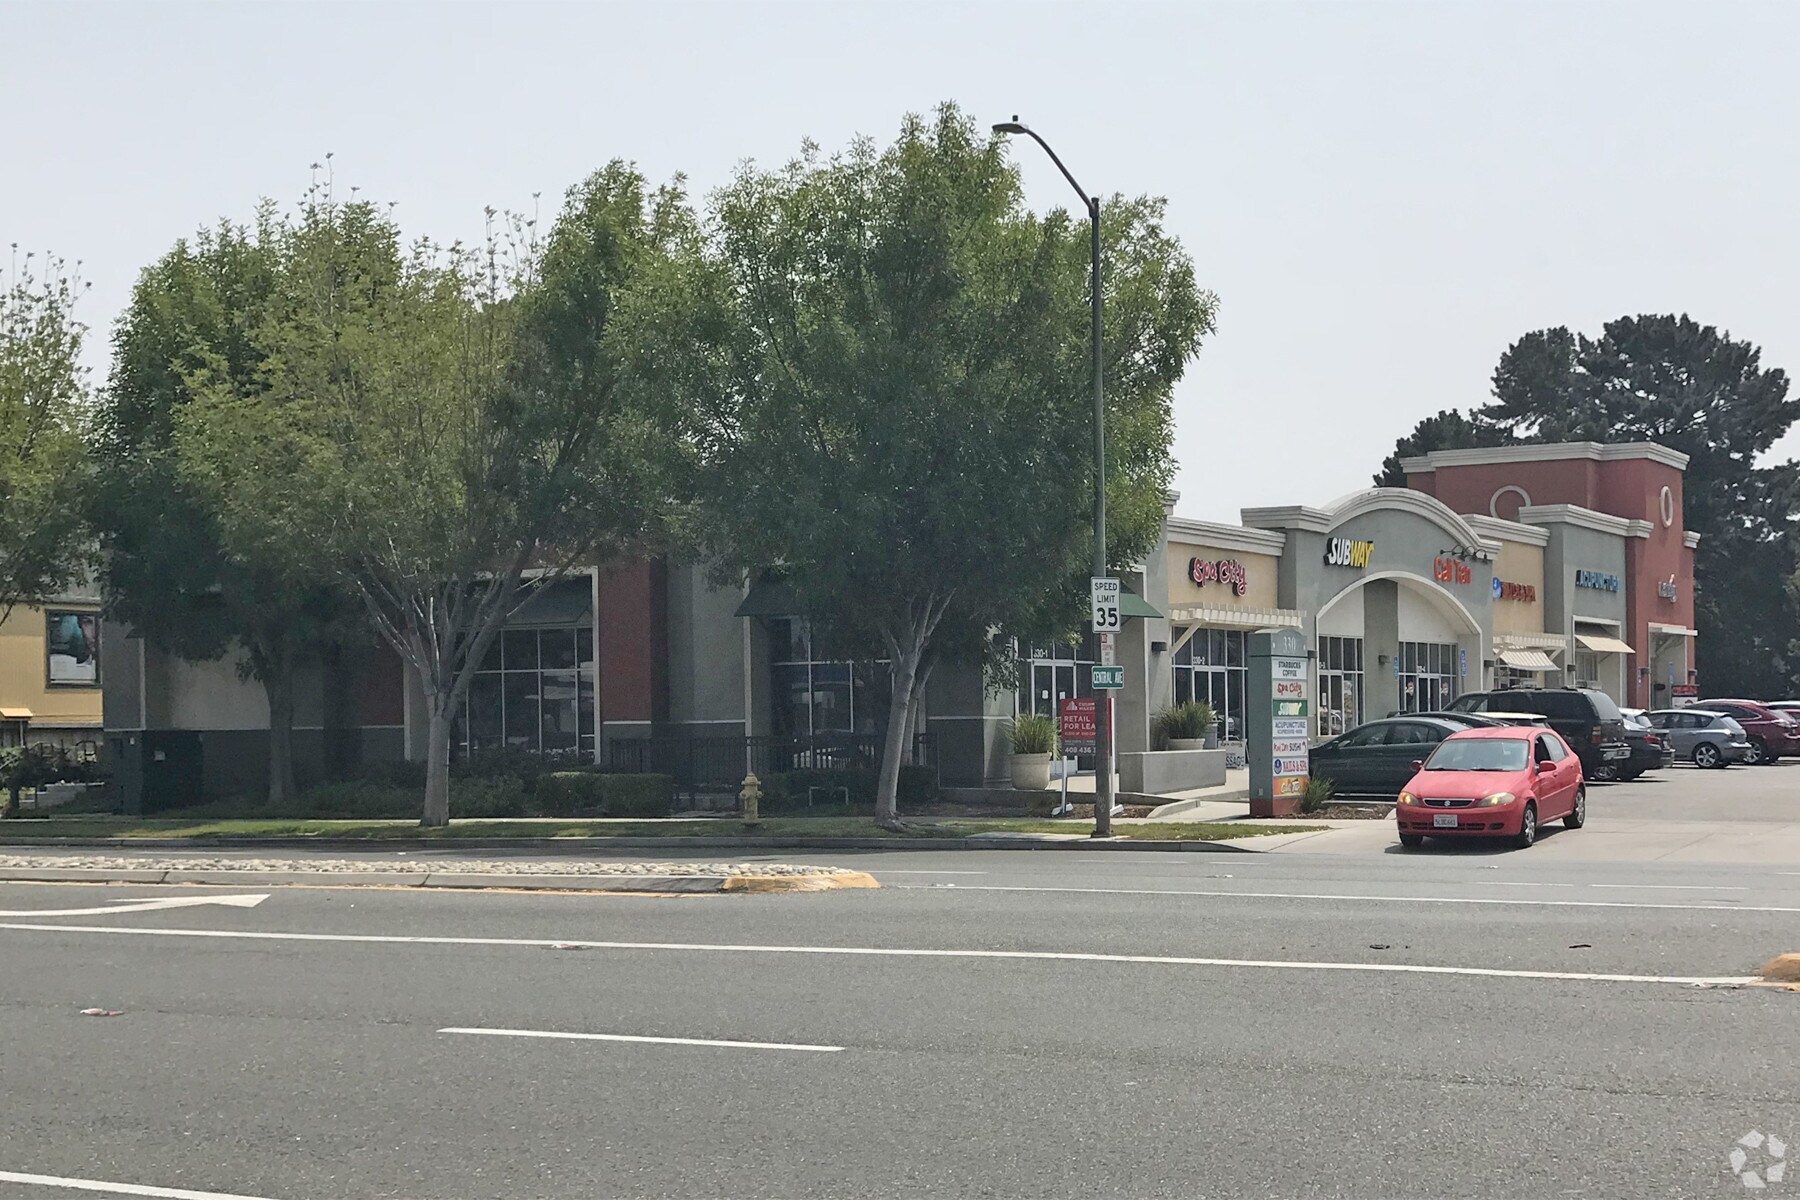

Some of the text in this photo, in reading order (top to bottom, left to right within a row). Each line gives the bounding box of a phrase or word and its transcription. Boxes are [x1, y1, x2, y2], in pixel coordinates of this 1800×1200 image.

[1325, 537, 1375, 568] SUBWAY
[1190, 557, 1247, 596] Spa City
[1094, 582, 1118, 591] SPEED
[1096, 595, 1116, 603] LIMIT
[1096, 607, 1118, 627] 35
[1283, 636, 1297, 653] 330
[1278, 661, 1302, 669] STARBUCKS
[1093, 671, 1123, 684] CENTRAL AVE
[1277, 682, 1303, 698] Spa City
[1274, 721, 1306, 729] ACUPUNCTURE
